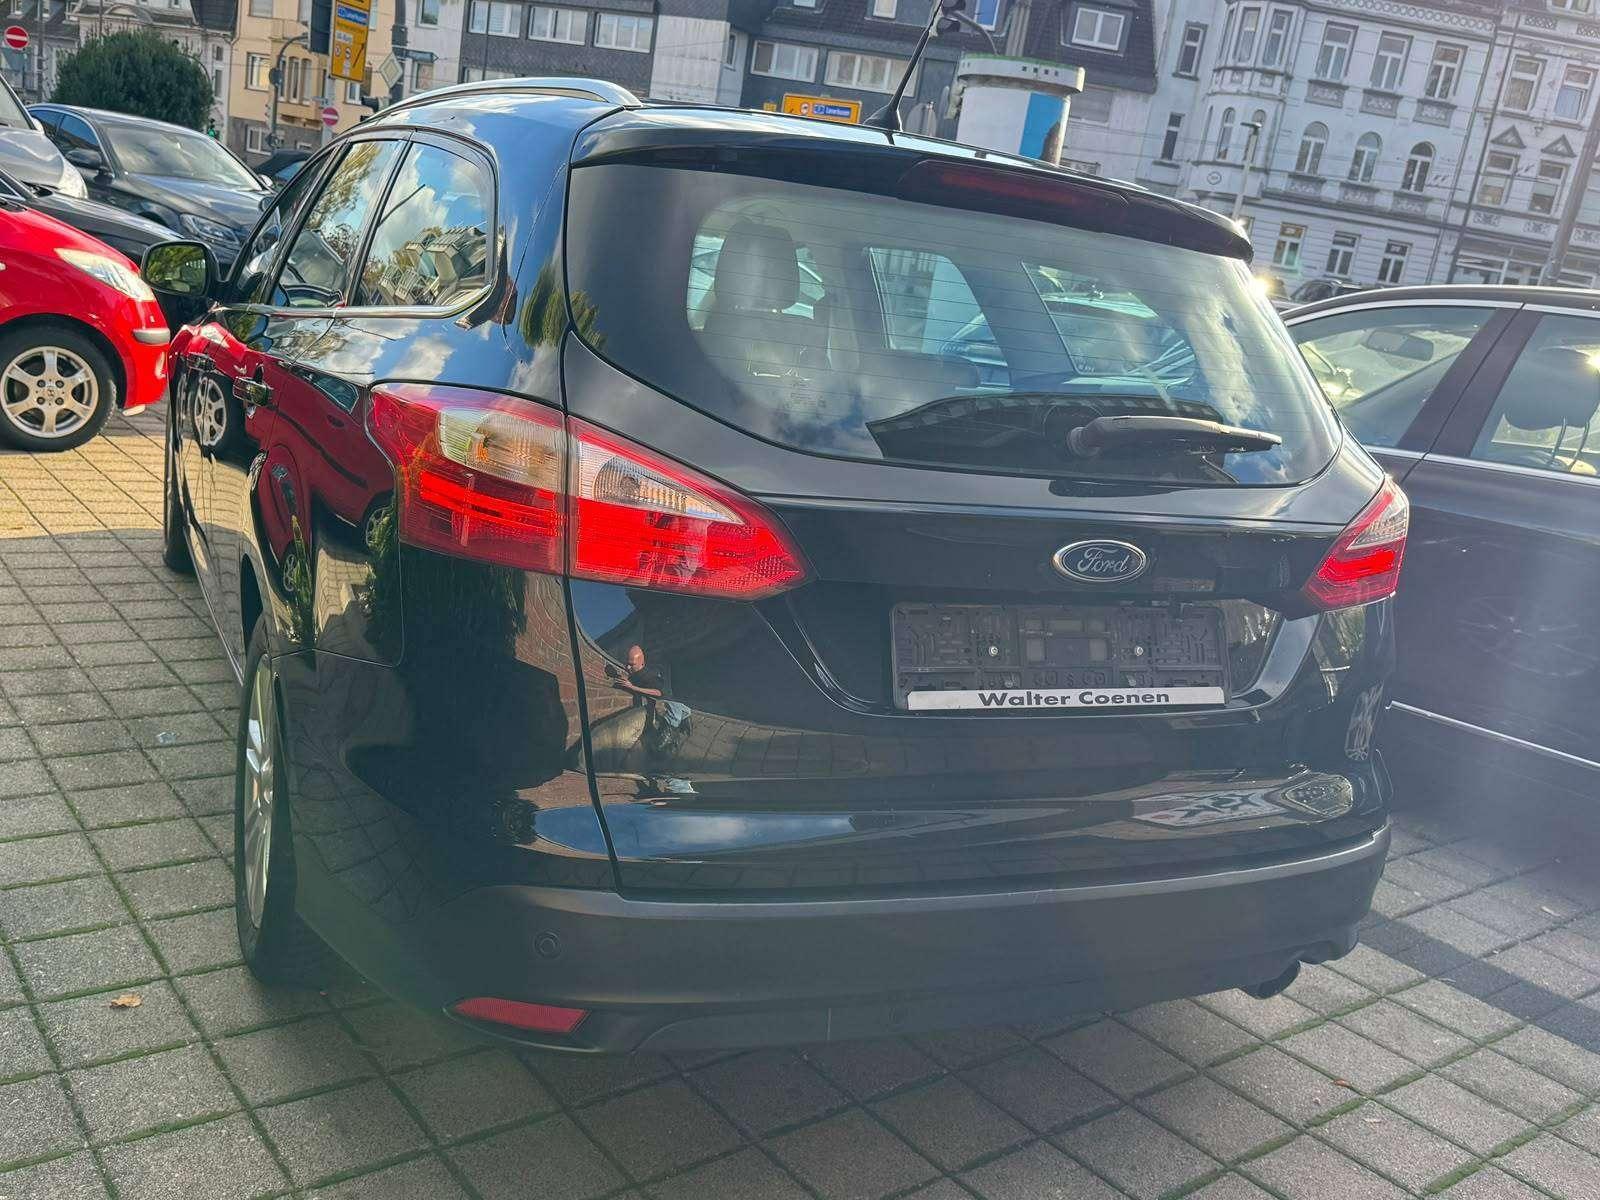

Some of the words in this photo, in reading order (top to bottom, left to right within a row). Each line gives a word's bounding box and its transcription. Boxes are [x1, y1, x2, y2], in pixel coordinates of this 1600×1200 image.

[1077, 547, 1130, 572] Ford
[978, 691, 1071, 707] Walter
[1078, 691, 1170, 705] Coenen
